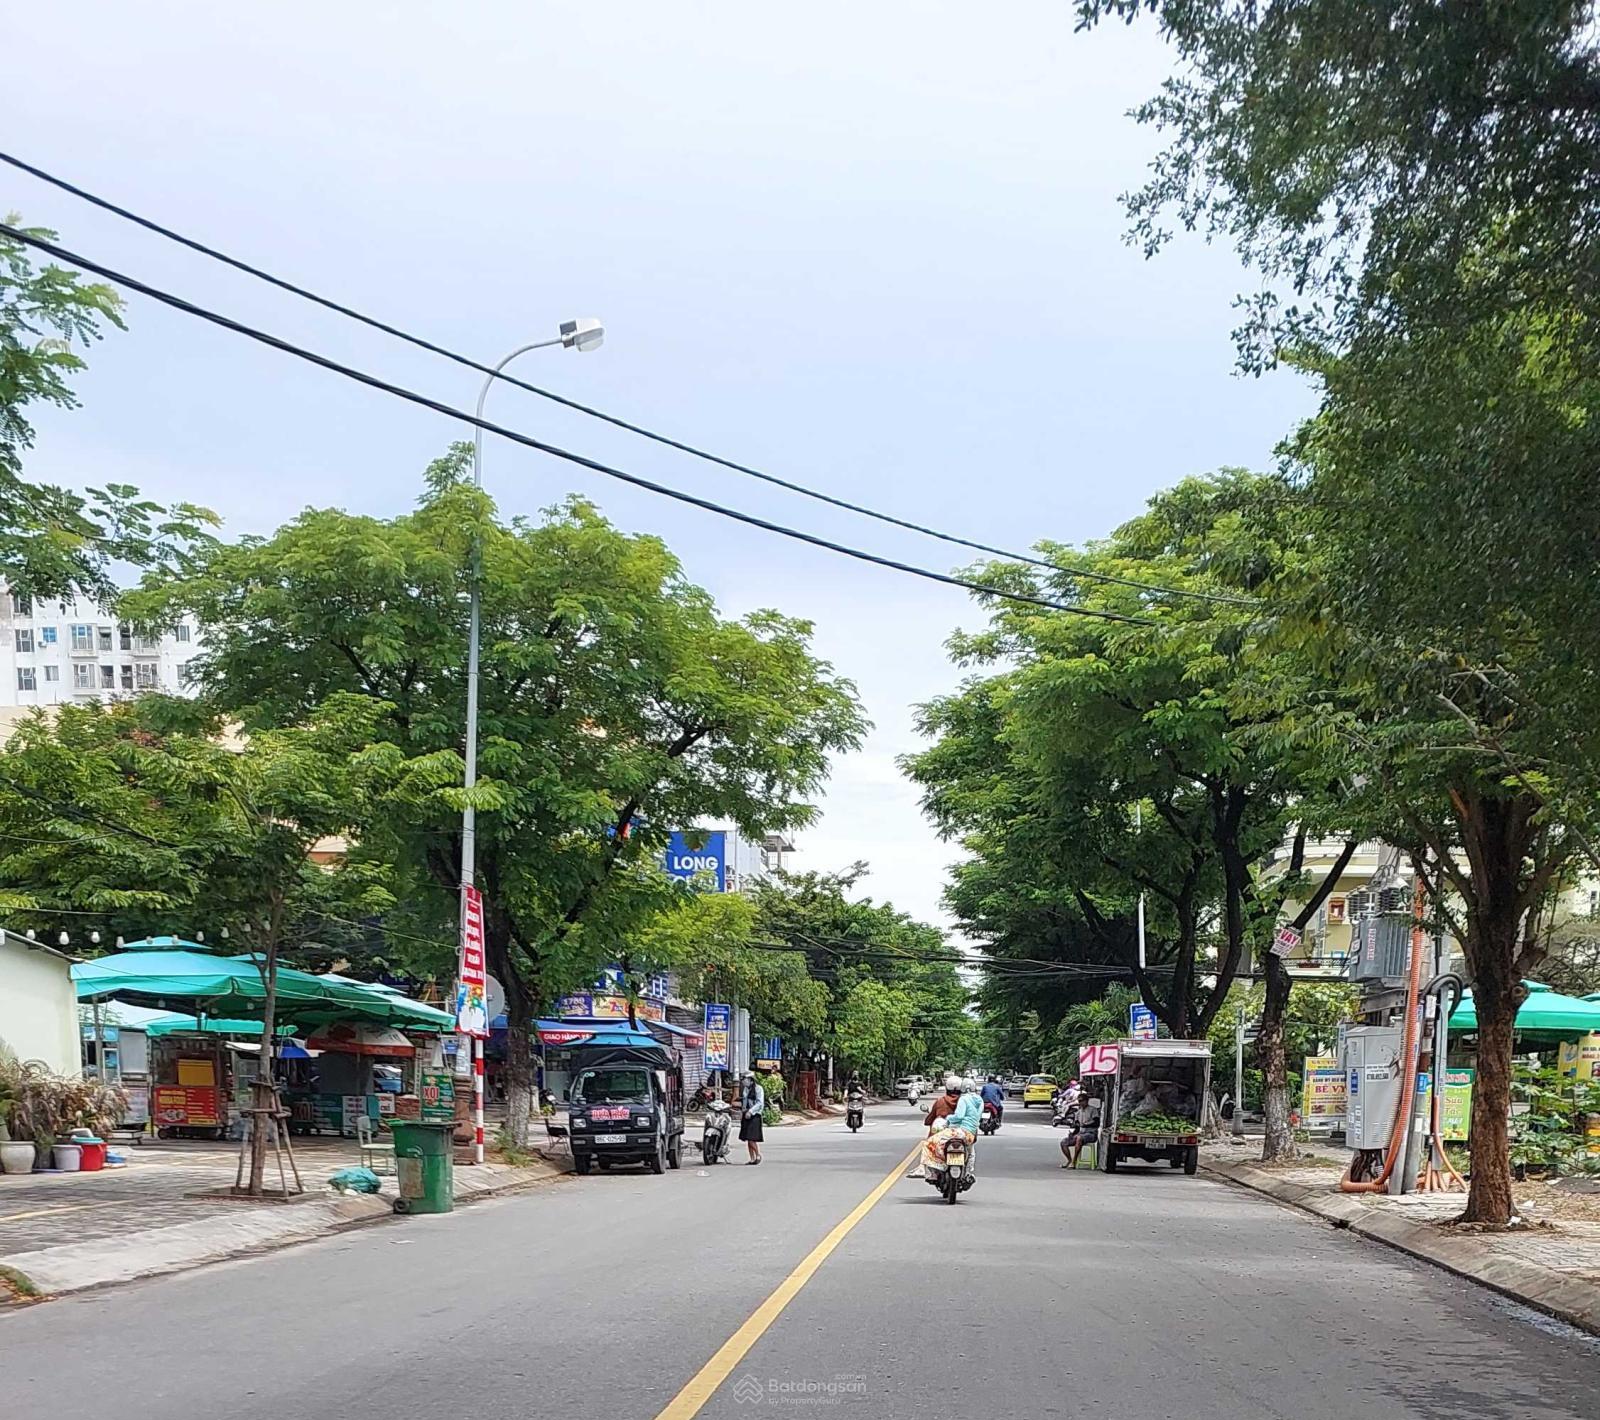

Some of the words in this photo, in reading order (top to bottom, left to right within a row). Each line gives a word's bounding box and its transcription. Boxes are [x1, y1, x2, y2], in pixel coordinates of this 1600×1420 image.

[673, 855, 719, 871] LONG
[1279, 928, 1300, 944] VAY
[543, 1032, 561, 1040] GIAO
[1080, 1045, 1119, 1074] 15
